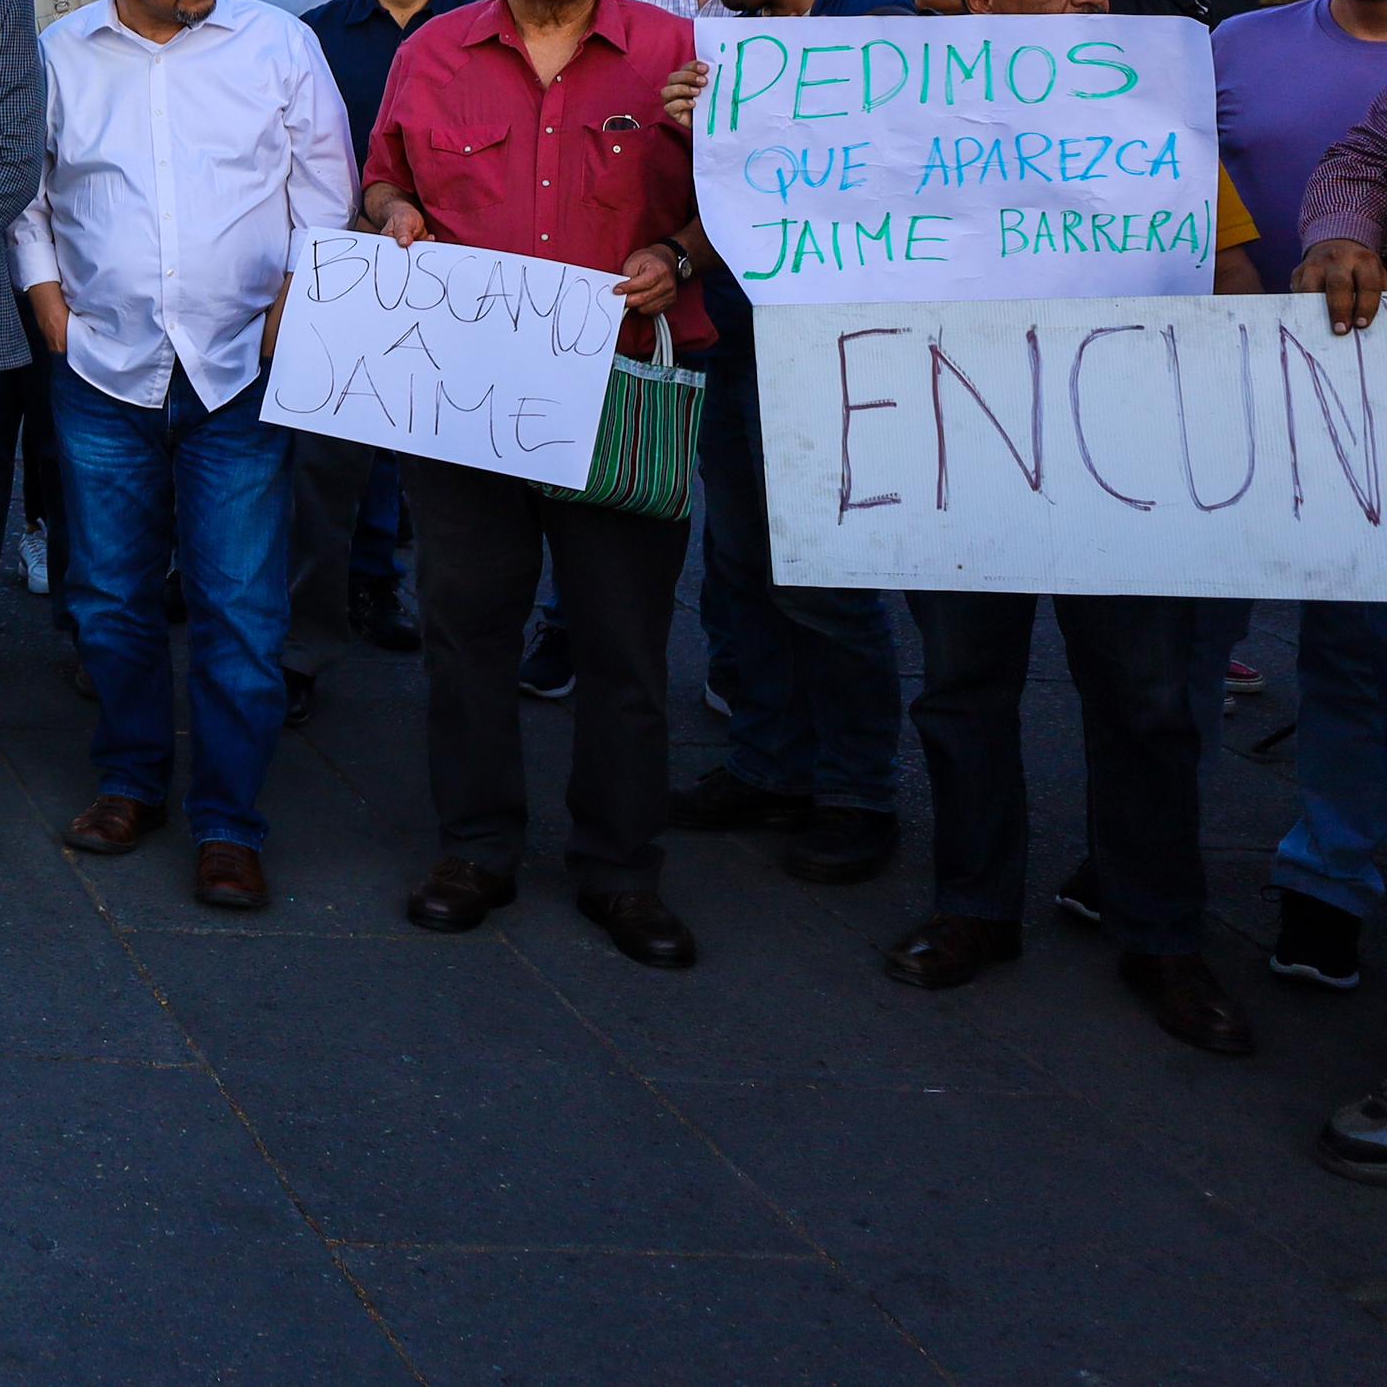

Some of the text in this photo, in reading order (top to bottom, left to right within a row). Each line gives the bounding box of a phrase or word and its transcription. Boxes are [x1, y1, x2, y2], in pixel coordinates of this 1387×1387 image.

[743, 131, 1181, 205] QUE APAREZCA
[743, 212, 954, 281] JAIME
[307, 237, 614, 356] BUSCAMOS
[383, 321, 441, 370] A
[275, 322, 576, 459] JAIME
